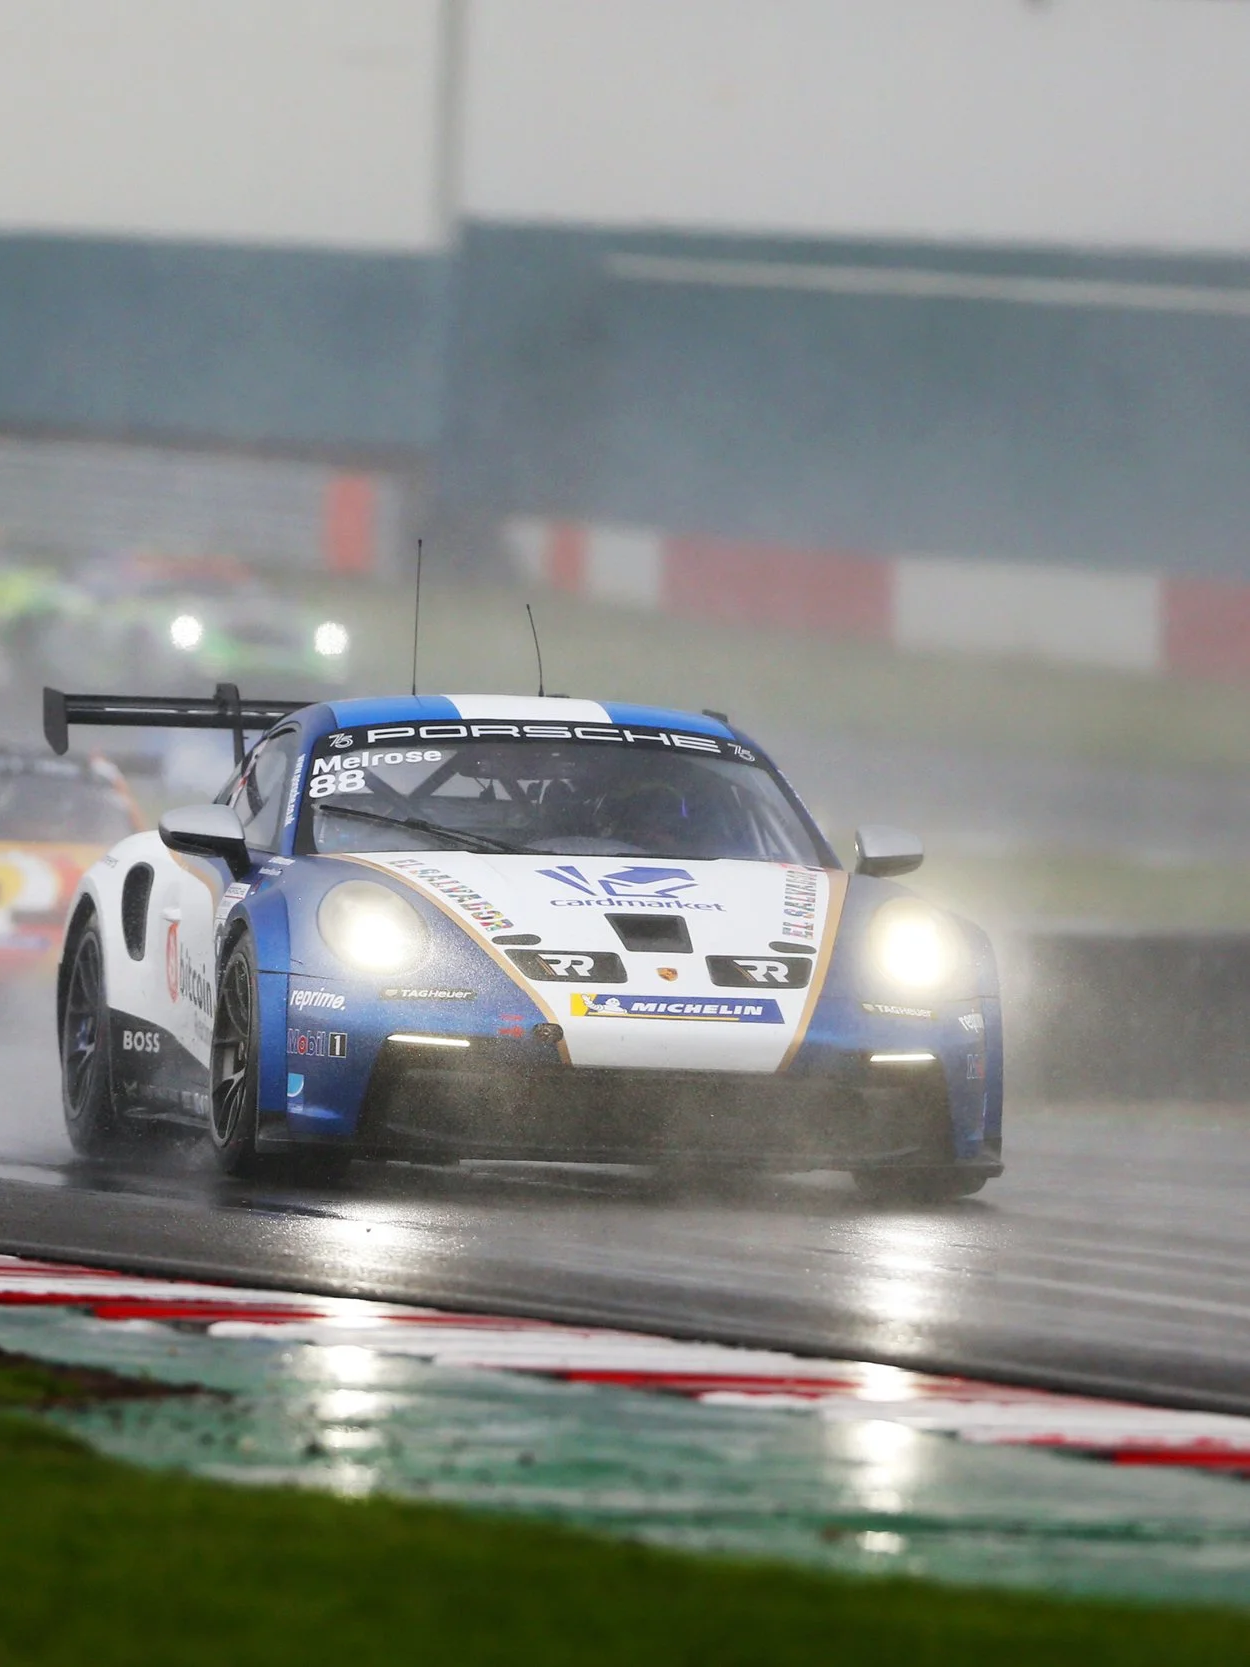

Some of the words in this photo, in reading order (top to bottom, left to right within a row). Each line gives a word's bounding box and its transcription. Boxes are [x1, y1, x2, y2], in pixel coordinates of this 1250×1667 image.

[329, 733, 353, 748] 75
[367, 725, 721, 754] PORSCHE
[312, 750, 442, 776] Melrose
[309, 769, 366, 799] 88
[409, 868, 514, 932] SALVADOR
[550, 898, 727, 912] cardmarket
[180, 942, 213, 1018] bitcoin
[631, 1002, 763, 1016] MICHELIN
[123, 1030, 160, 1053] BOSS
[287, 1028, 325, 1057] Mobil
